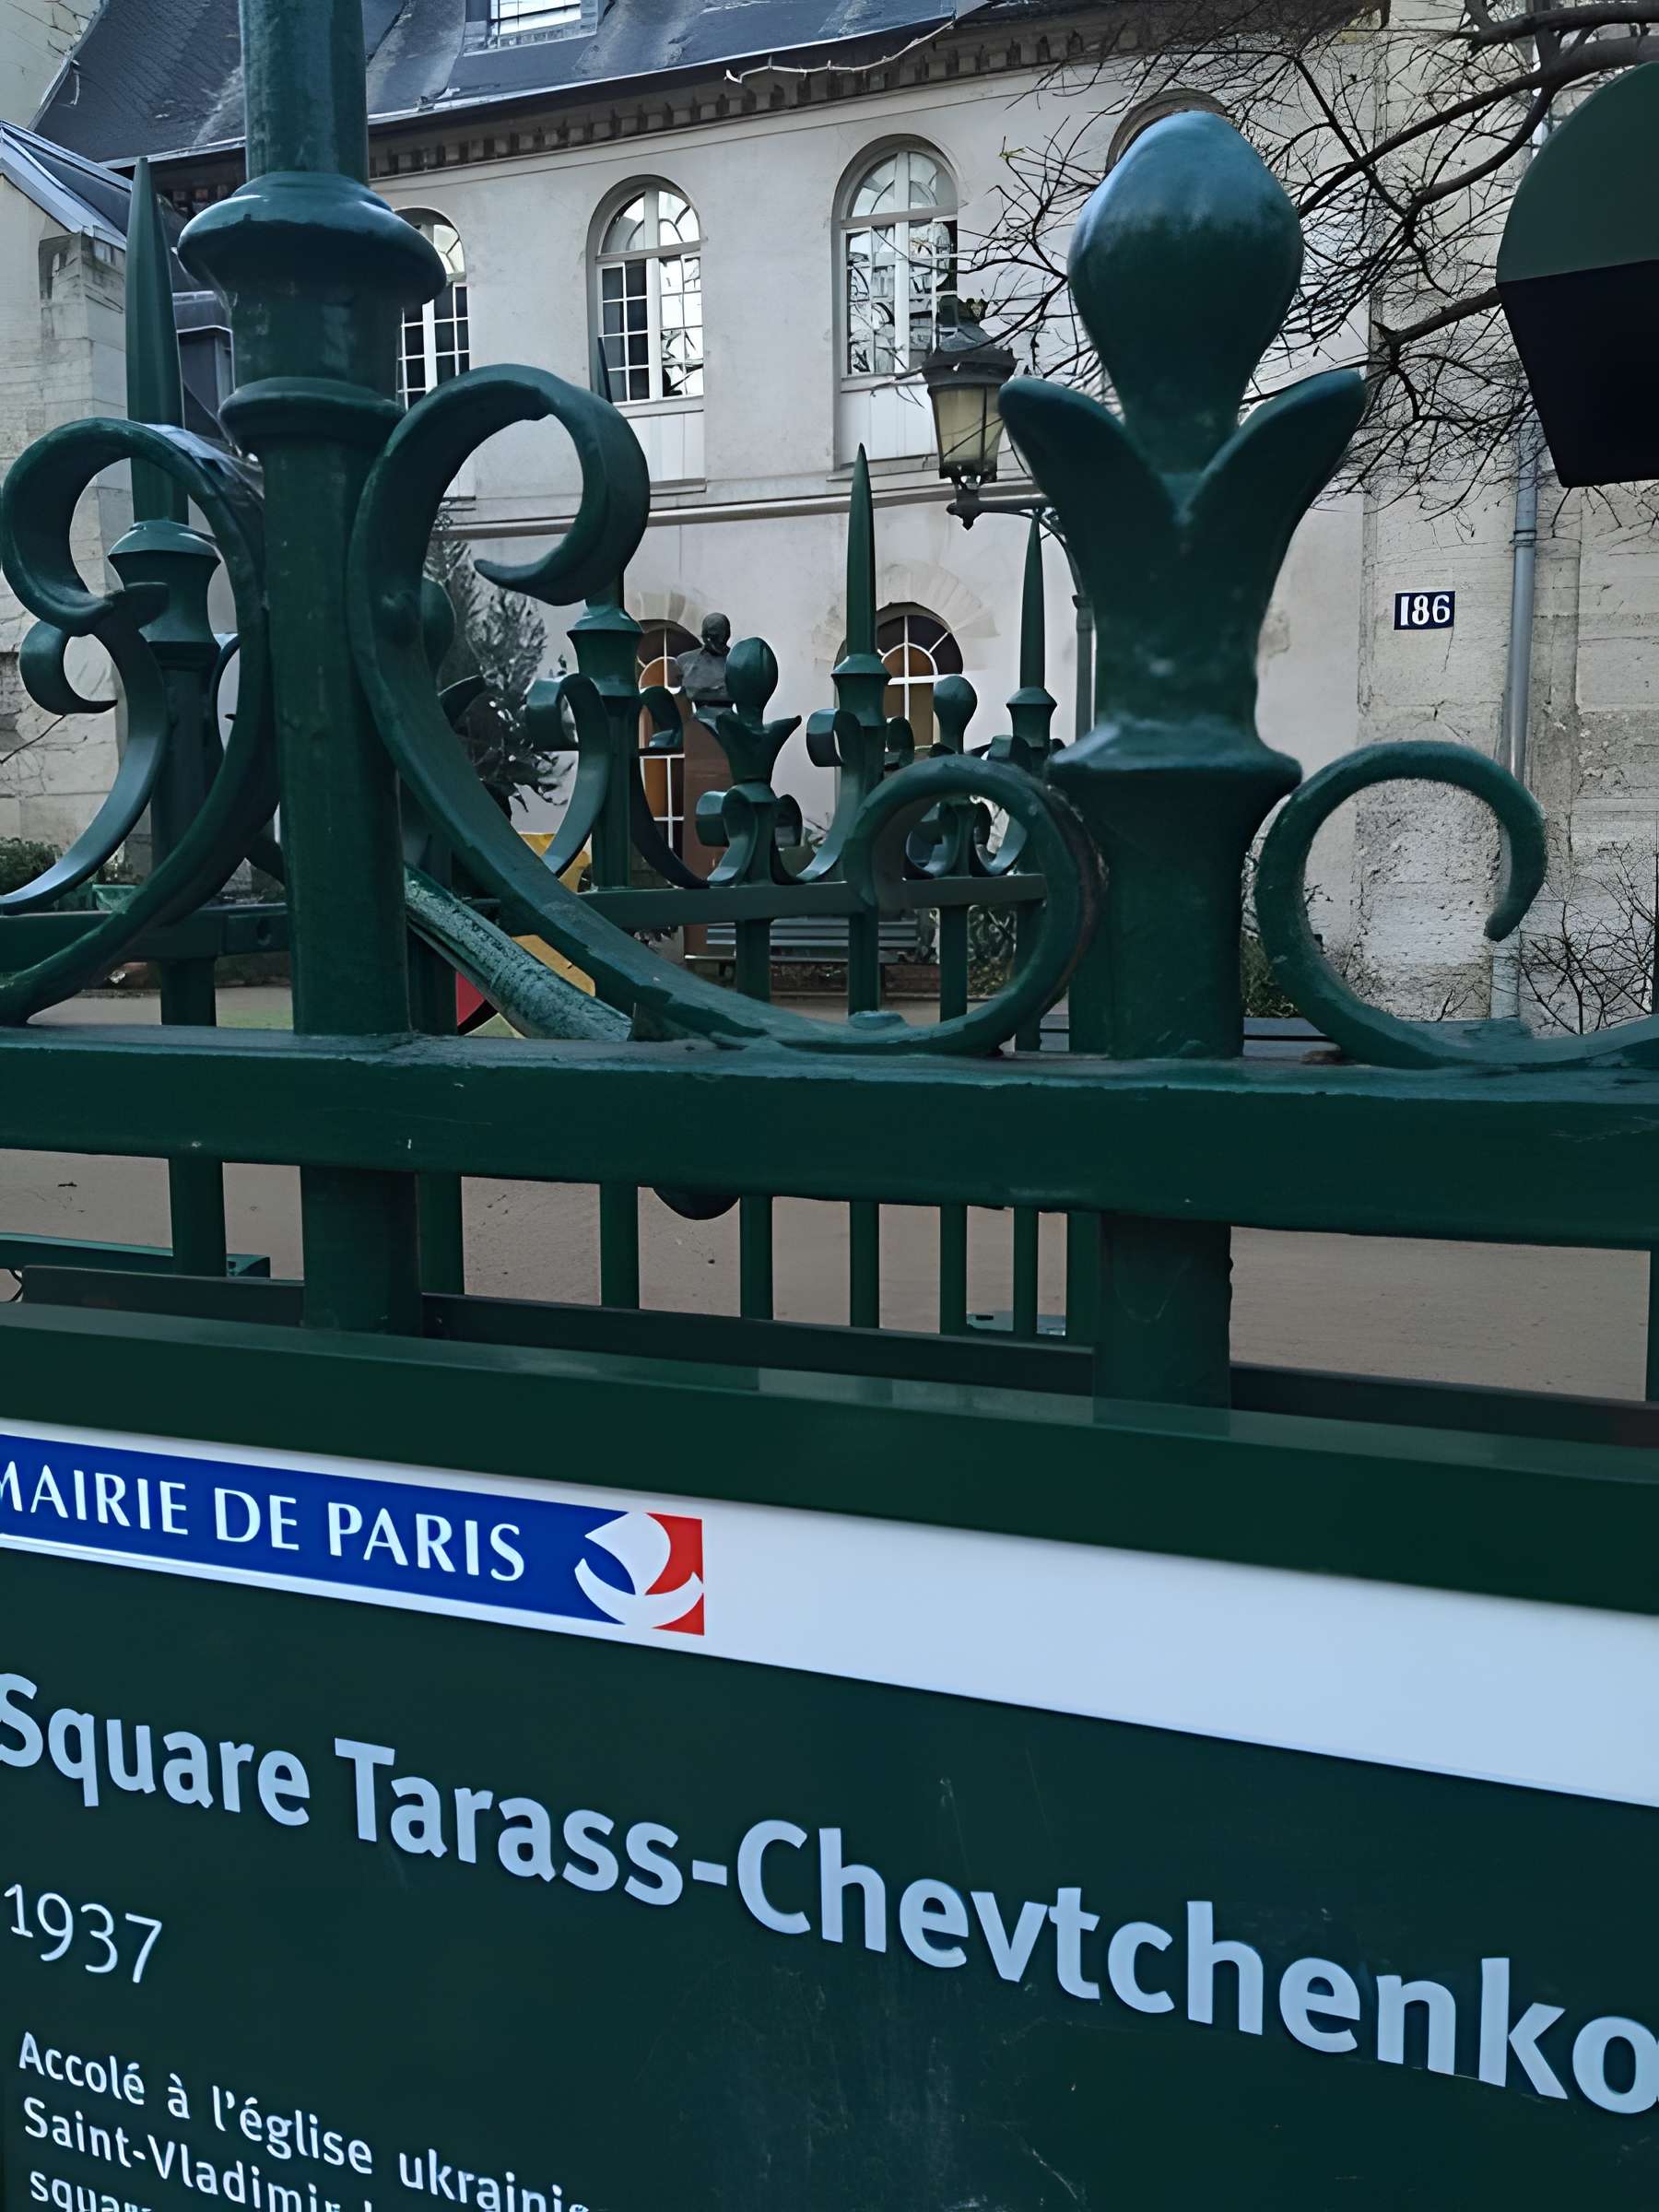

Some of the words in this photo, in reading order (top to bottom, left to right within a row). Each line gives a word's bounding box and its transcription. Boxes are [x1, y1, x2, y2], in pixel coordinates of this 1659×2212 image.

[1400, 594, 1451, 626] 186
[214, 1487, 300, 1550] DE
[327, 1501, 524, 1582] PARIS
[0, 1673, 311, 1826] Square
[335, 1737, 1659, 2113] Tarass-Chevtchenko
[4, 1883, 162, 1983] 1937
[18, 2031, 145, 2106] Accolé
[167, 2073, 191, 2120] à
[212, 2085, 372, 2174] l'église
[399, 2148, 589, 2212] ukraini
